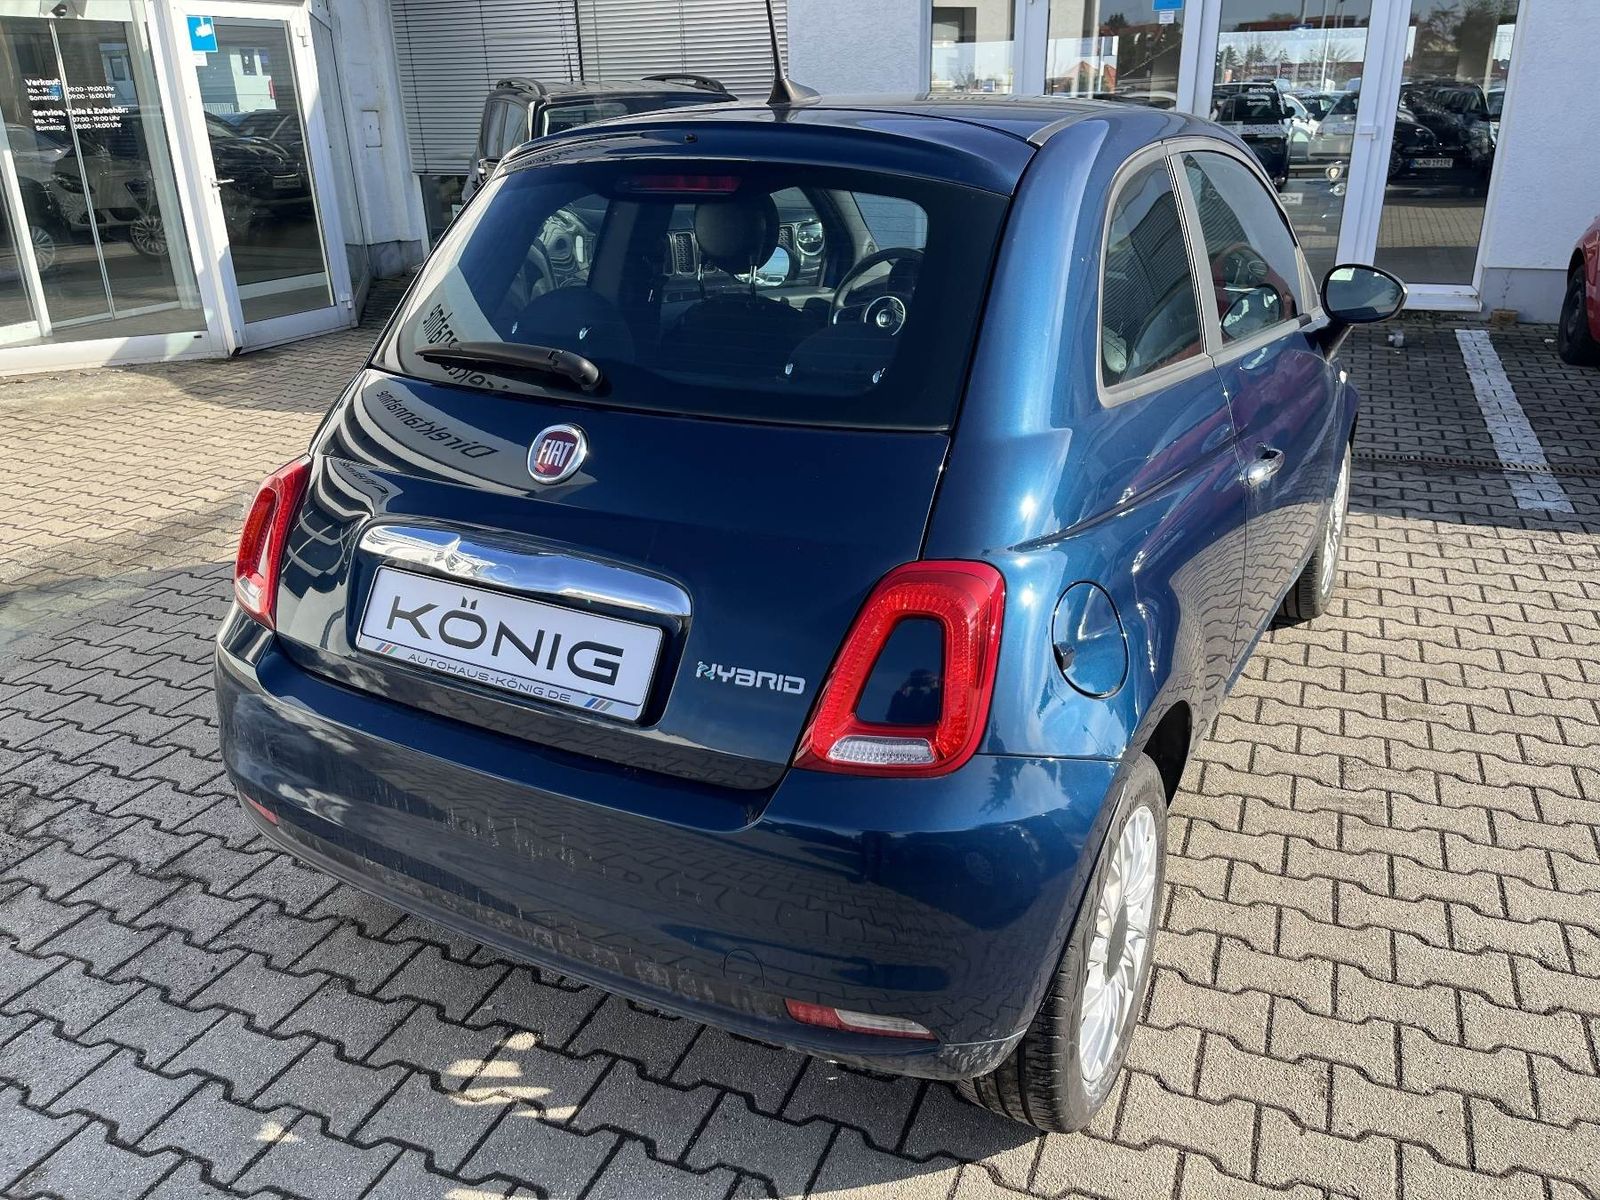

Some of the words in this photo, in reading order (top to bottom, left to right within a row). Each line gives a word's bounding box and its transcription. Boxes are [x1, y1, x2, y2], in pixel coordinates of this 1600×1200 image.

[25, 78, 61, 86] Verkauf:
[32, 109, 66, 117] Service,
[94, 106, 128, 115] Zubehör:
[537, 438, 575, 468] FIAT
[386, 595, 625, 686] KÖNIG
[407, 652, 571, 704] AUTOHAUS-KÖNIG.DE
[695, 661, 806, 695] HYBRID
